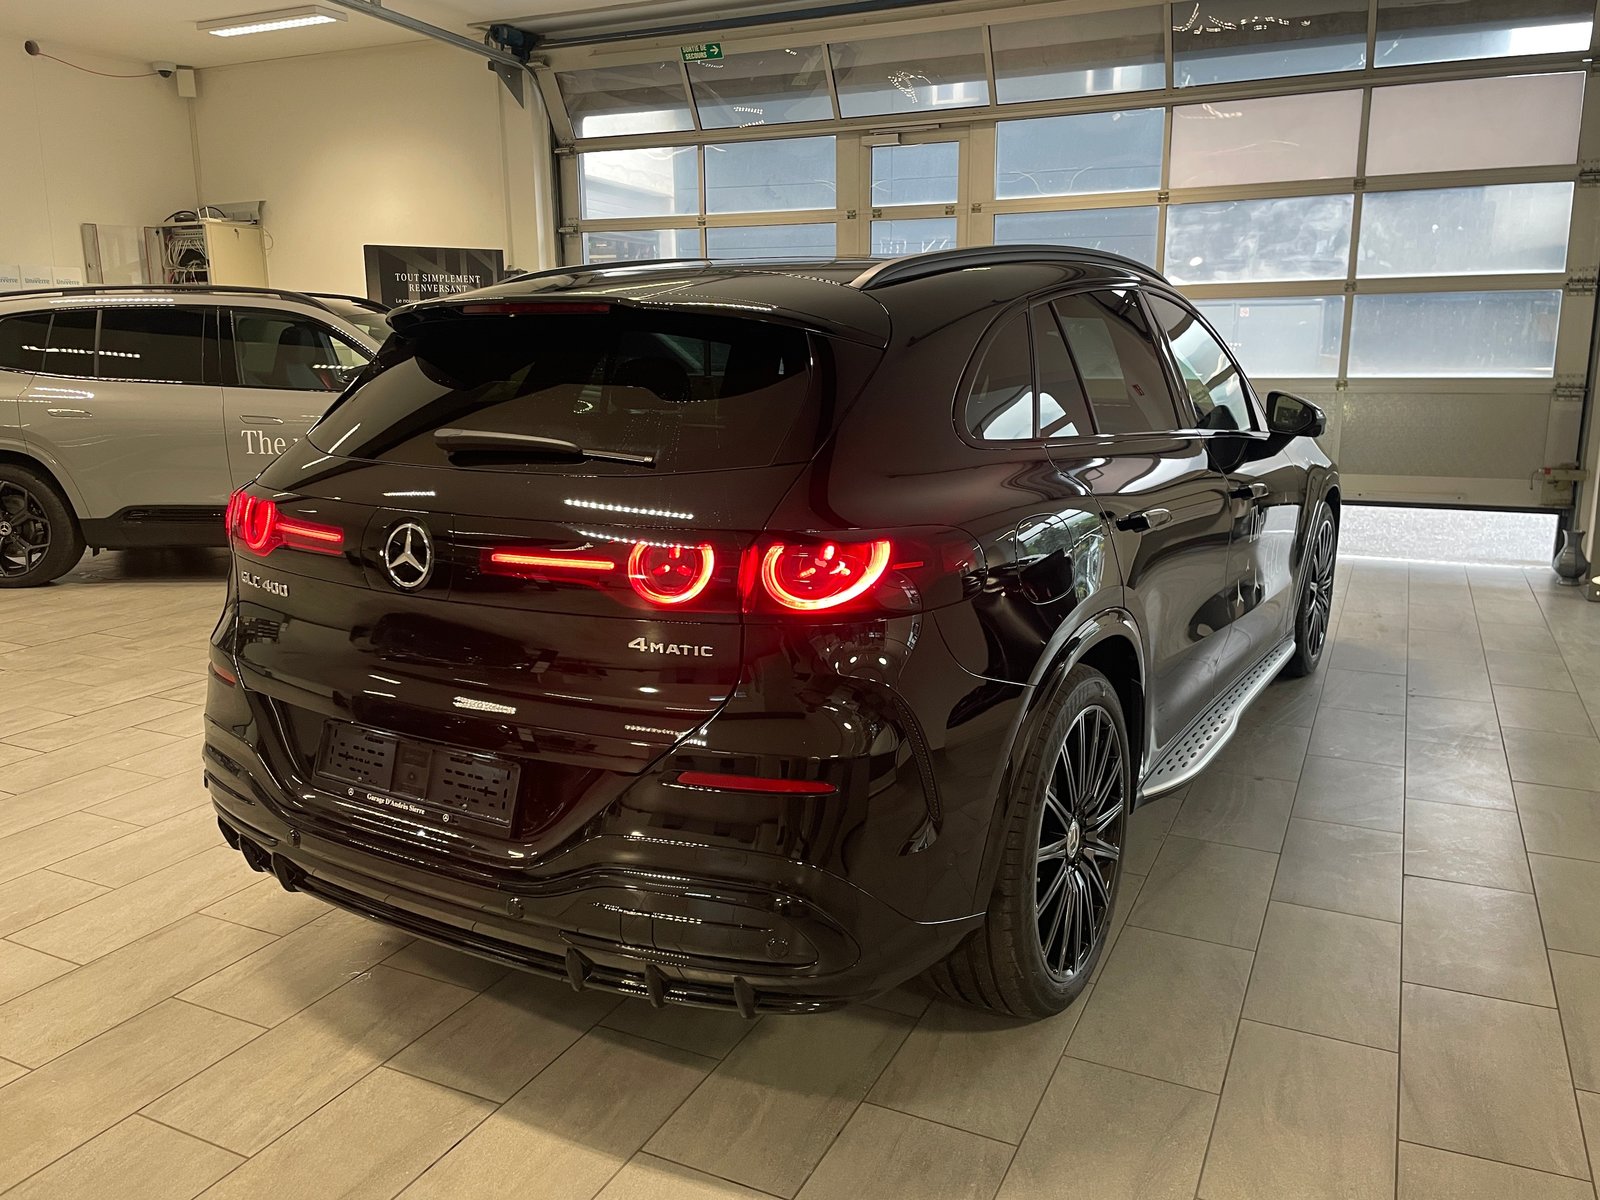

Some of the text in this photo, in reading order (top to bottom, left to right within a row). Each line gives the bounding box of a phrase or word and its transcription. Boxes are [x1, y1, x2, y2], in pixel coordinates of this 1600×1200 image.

[685, 51, 707, 60] SECOURS
[395, 272, 481, 284] TOUT SIMPLEMENT
[409, 284, 467, 293] RENVERSANT
[241, 430, 286, 455] The
[241, 570, 288, 597] GLC 400
[628, 637, 714, 657] 4MATIC
[366, 792, 385, 804] Garage
[408, 804, 425, 815] Sierre
